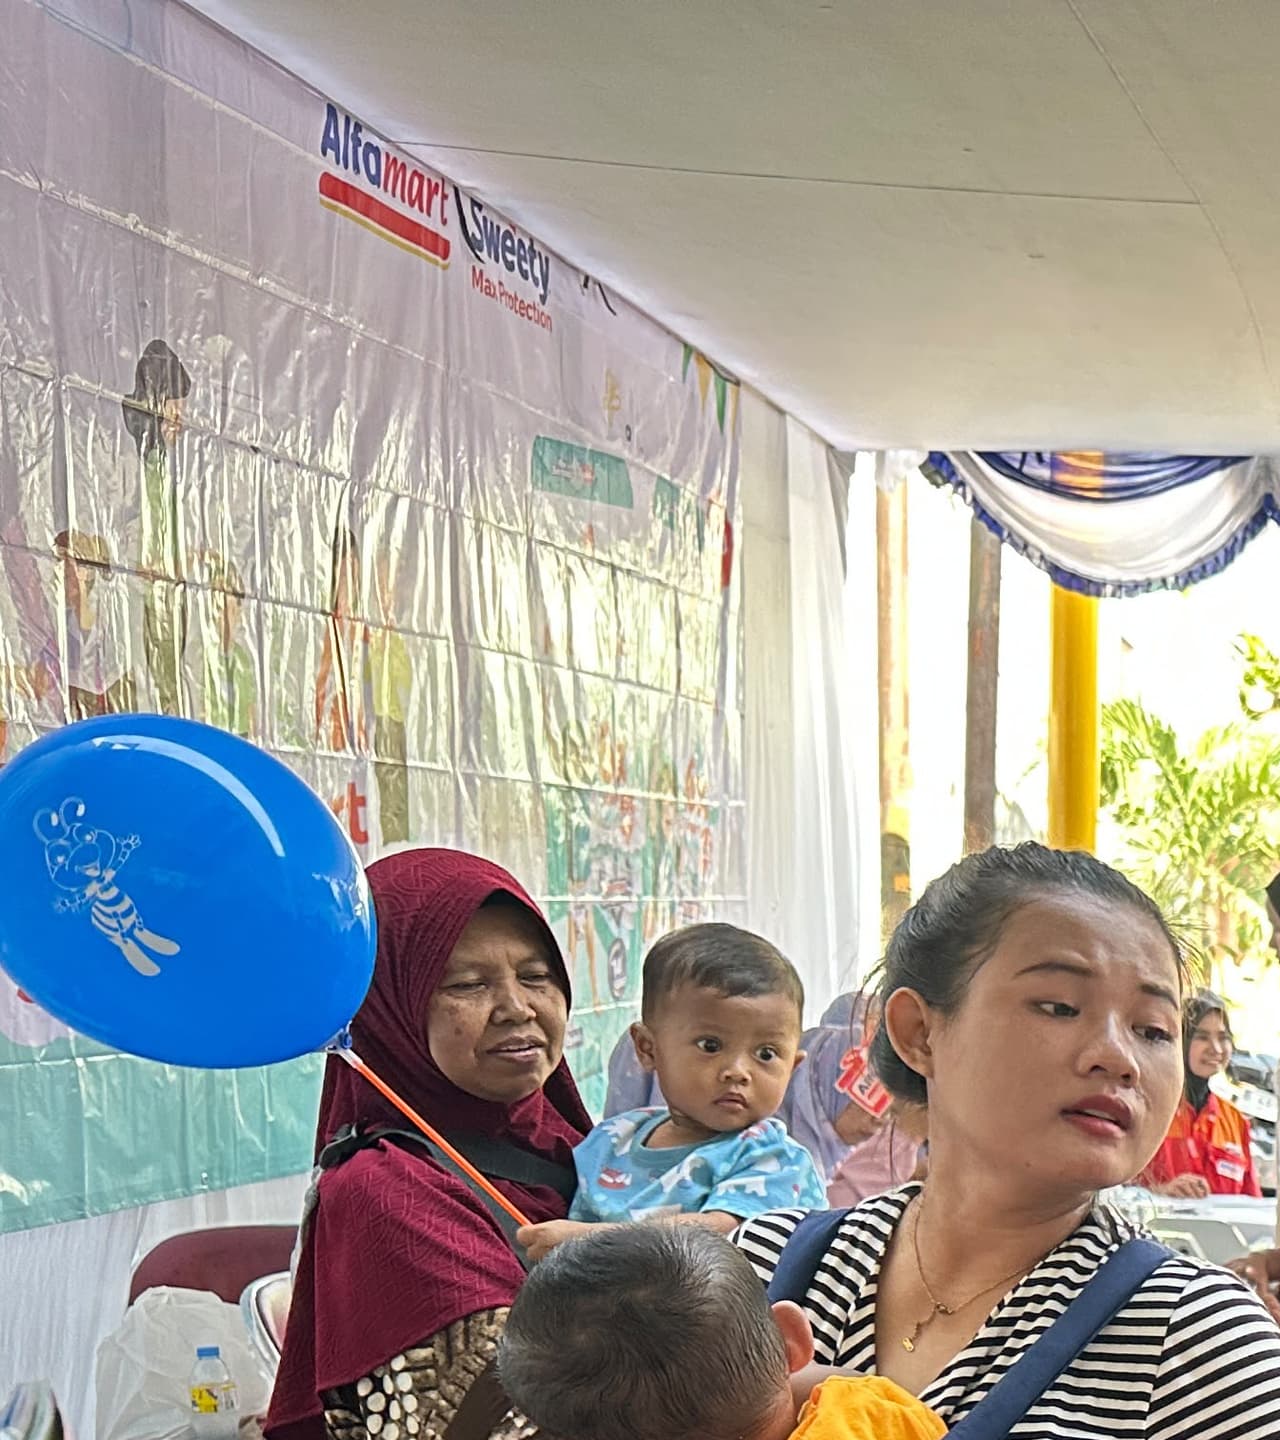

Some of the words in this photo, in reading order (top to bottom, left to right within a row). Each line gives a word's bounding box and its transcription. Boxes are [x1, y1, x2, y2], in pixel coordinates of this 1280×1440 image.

[320, 102, 448, 226] Alfamart
[469, 197, 550, 304] Sweety
[472, 265, 497, 298] Max
[499, 279, 552, 332] Protection
